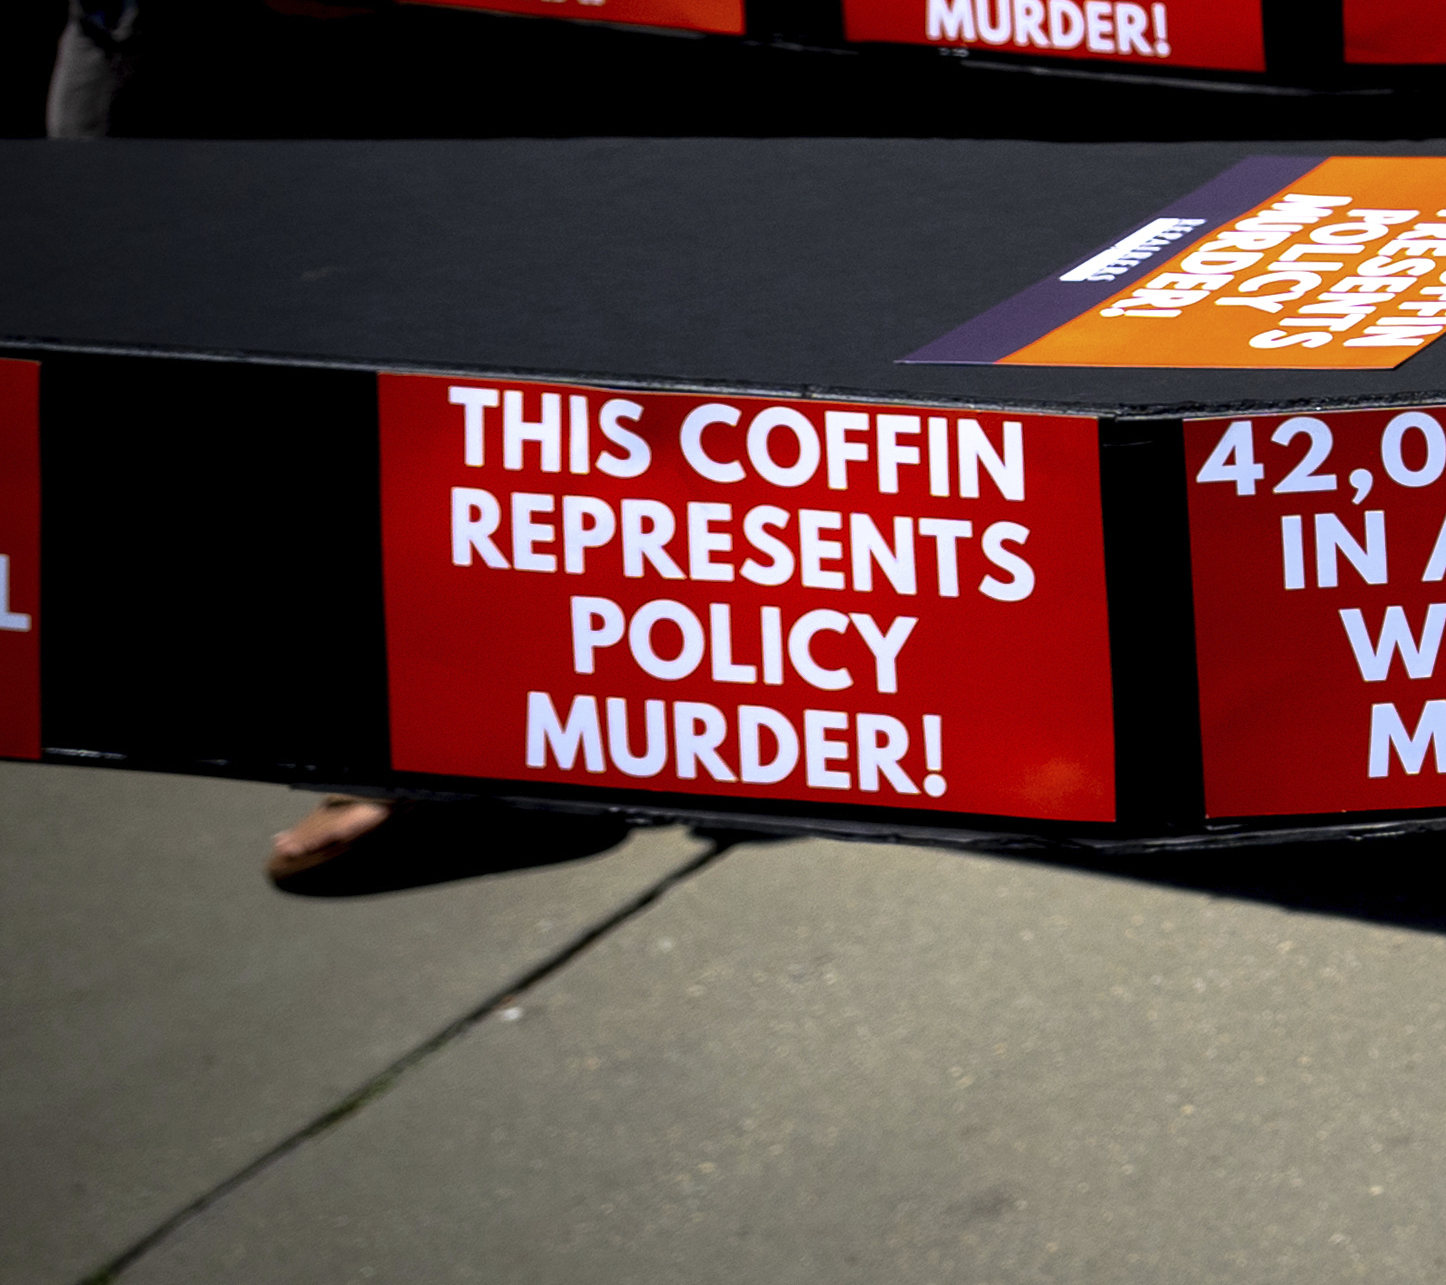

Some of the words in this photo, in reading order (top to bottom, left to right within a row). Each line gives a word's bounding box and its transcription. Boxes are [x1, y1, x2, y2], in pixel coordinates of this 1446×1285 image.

[1100, 193, 1353, 318] MURDER!
[1215, 208, 1420, 314] POLICY
[449, 386, 651, 478] THIS
[680, 403, 1024, 501] COFFIN
[452, 487, 1035, 602] REPRESENTS
[1281, 510, 1387, 590] IN
[571, 596, 917, 693] POLICY
[527, 691, 946, 797] MURDER!
